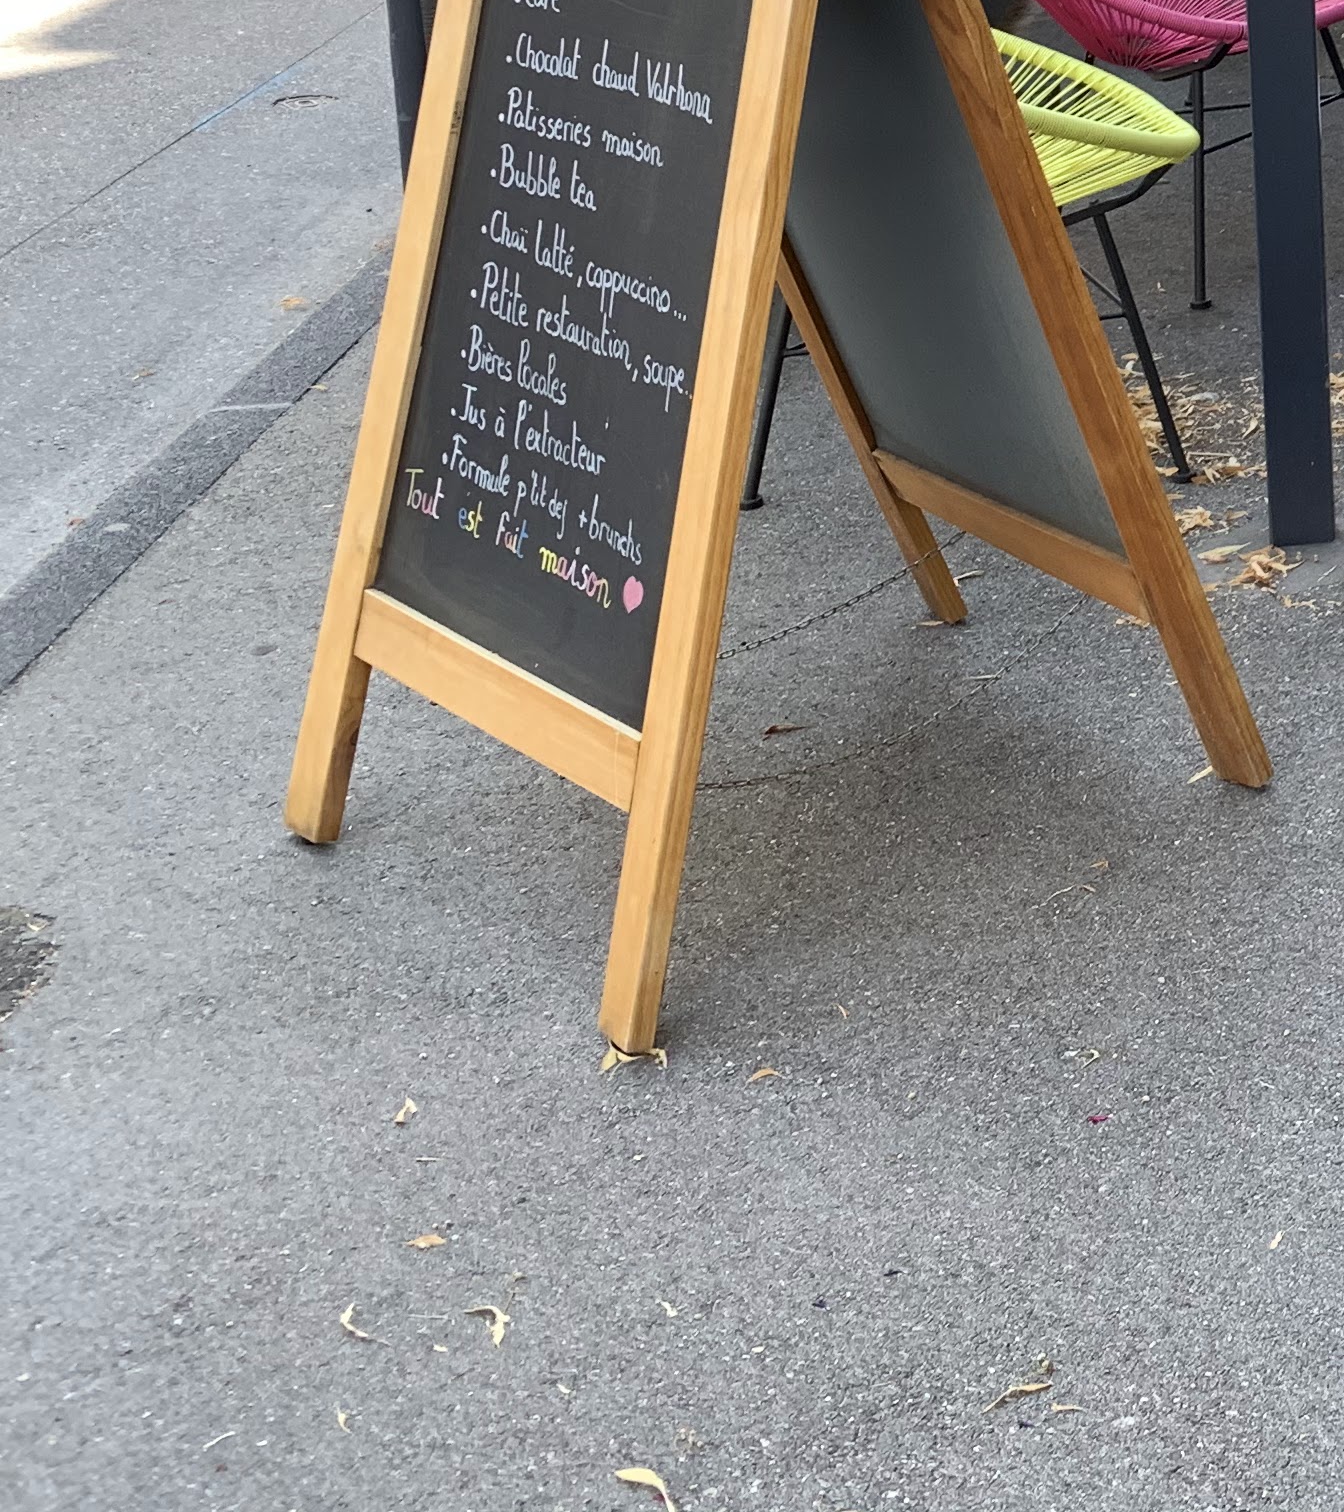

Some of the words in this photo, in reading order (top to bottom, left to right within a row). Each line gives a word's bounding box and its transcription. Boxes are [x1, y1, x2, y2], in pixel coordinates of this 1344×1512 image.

[516, 33, 581, 79] Chocolat
[592, 39, 640, 96] chaud
[647, 59, 713, 124] Valrhona
[500, 144, 560, 199] Bubble
[570, 160, 597, 211] tea
[602, 130, 664, 167] maison
[480, 261, 528, 327] Petite
[468, 325, 512, 382] Bières
[517, 339, 567, 405] locales
[449, 434, 510, 496] Formule
[459, 383, 486, 430] Jus
[494, 408, 505, 438] à
[514, 400, 606, 476] l'extracteur
[405, 468, 445, 520] Tout
[495, 511, 528, 559] fait
[539, 546, 611, 609] maison
